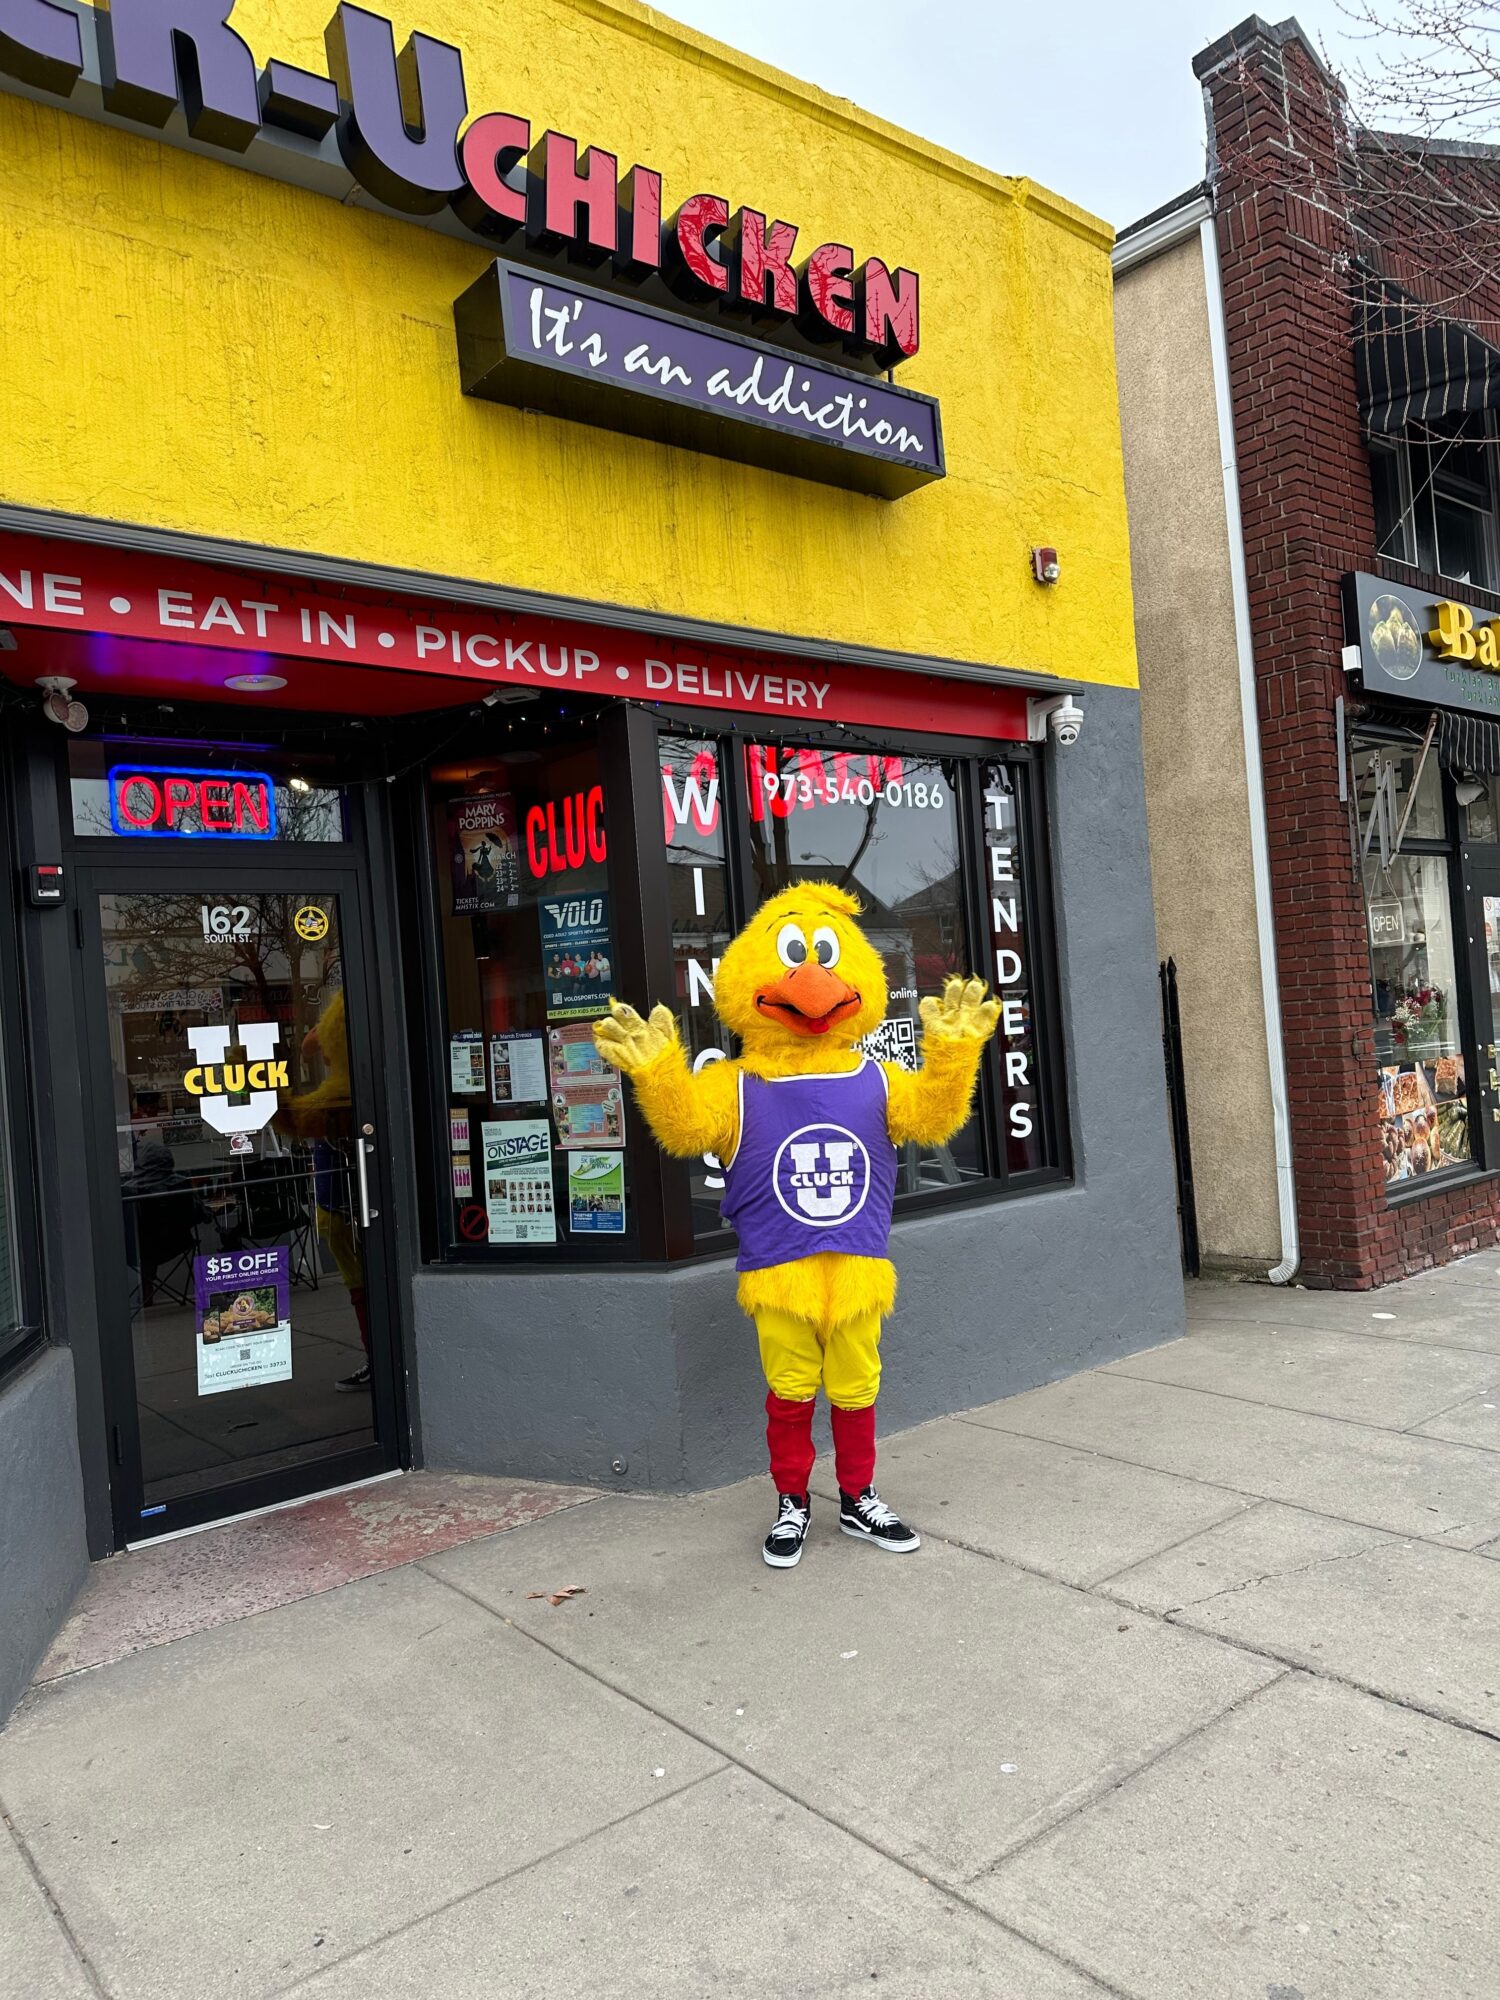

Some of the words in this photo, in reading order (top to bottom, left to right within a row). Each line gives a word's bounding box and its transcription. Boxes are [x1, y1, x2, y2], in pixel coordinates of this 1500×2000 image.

[462, 111, 920, 358] CHICKEN
[530, 287, 608, 367] It's
[623, 344, 692, 387] an
[706, 356, 924, 453] addiction
[157, 588, 279, 638] EAT
[300, 607, 357, 649] IN
[415, 625, 600, 680] PICKUP
[645, 658, 831, 709] DELIVERY
[118, 775, 269, 830] OPEN
[763, 772, 944, 809] 973-540-0186
[458, 812, 505, 830] POPPINS
[465, 802, 497, 819] MARY
[456, 896, 479, 905] TICKETS
[544, 898, 603, 929] VOLO
[201, 905, 252, 934] 162
[1372, 915, 1399, 932] OPEN
[204, 934, 236, 944] SOUTH
[238, 934, 253, 943] ST.
[985, 795, 1034, 1139] TENDERS
[563, 992, 611, 1002] VOLOSPORTS.COM
[890, 988, 918, 1000] online
[183, 1060, 290, 1095] CLUCK
[790, 1170, 854, 1187] CLUCK
[206, 1256, 233, 1276] $5
[238, 1252, 278, 1271] OFF
